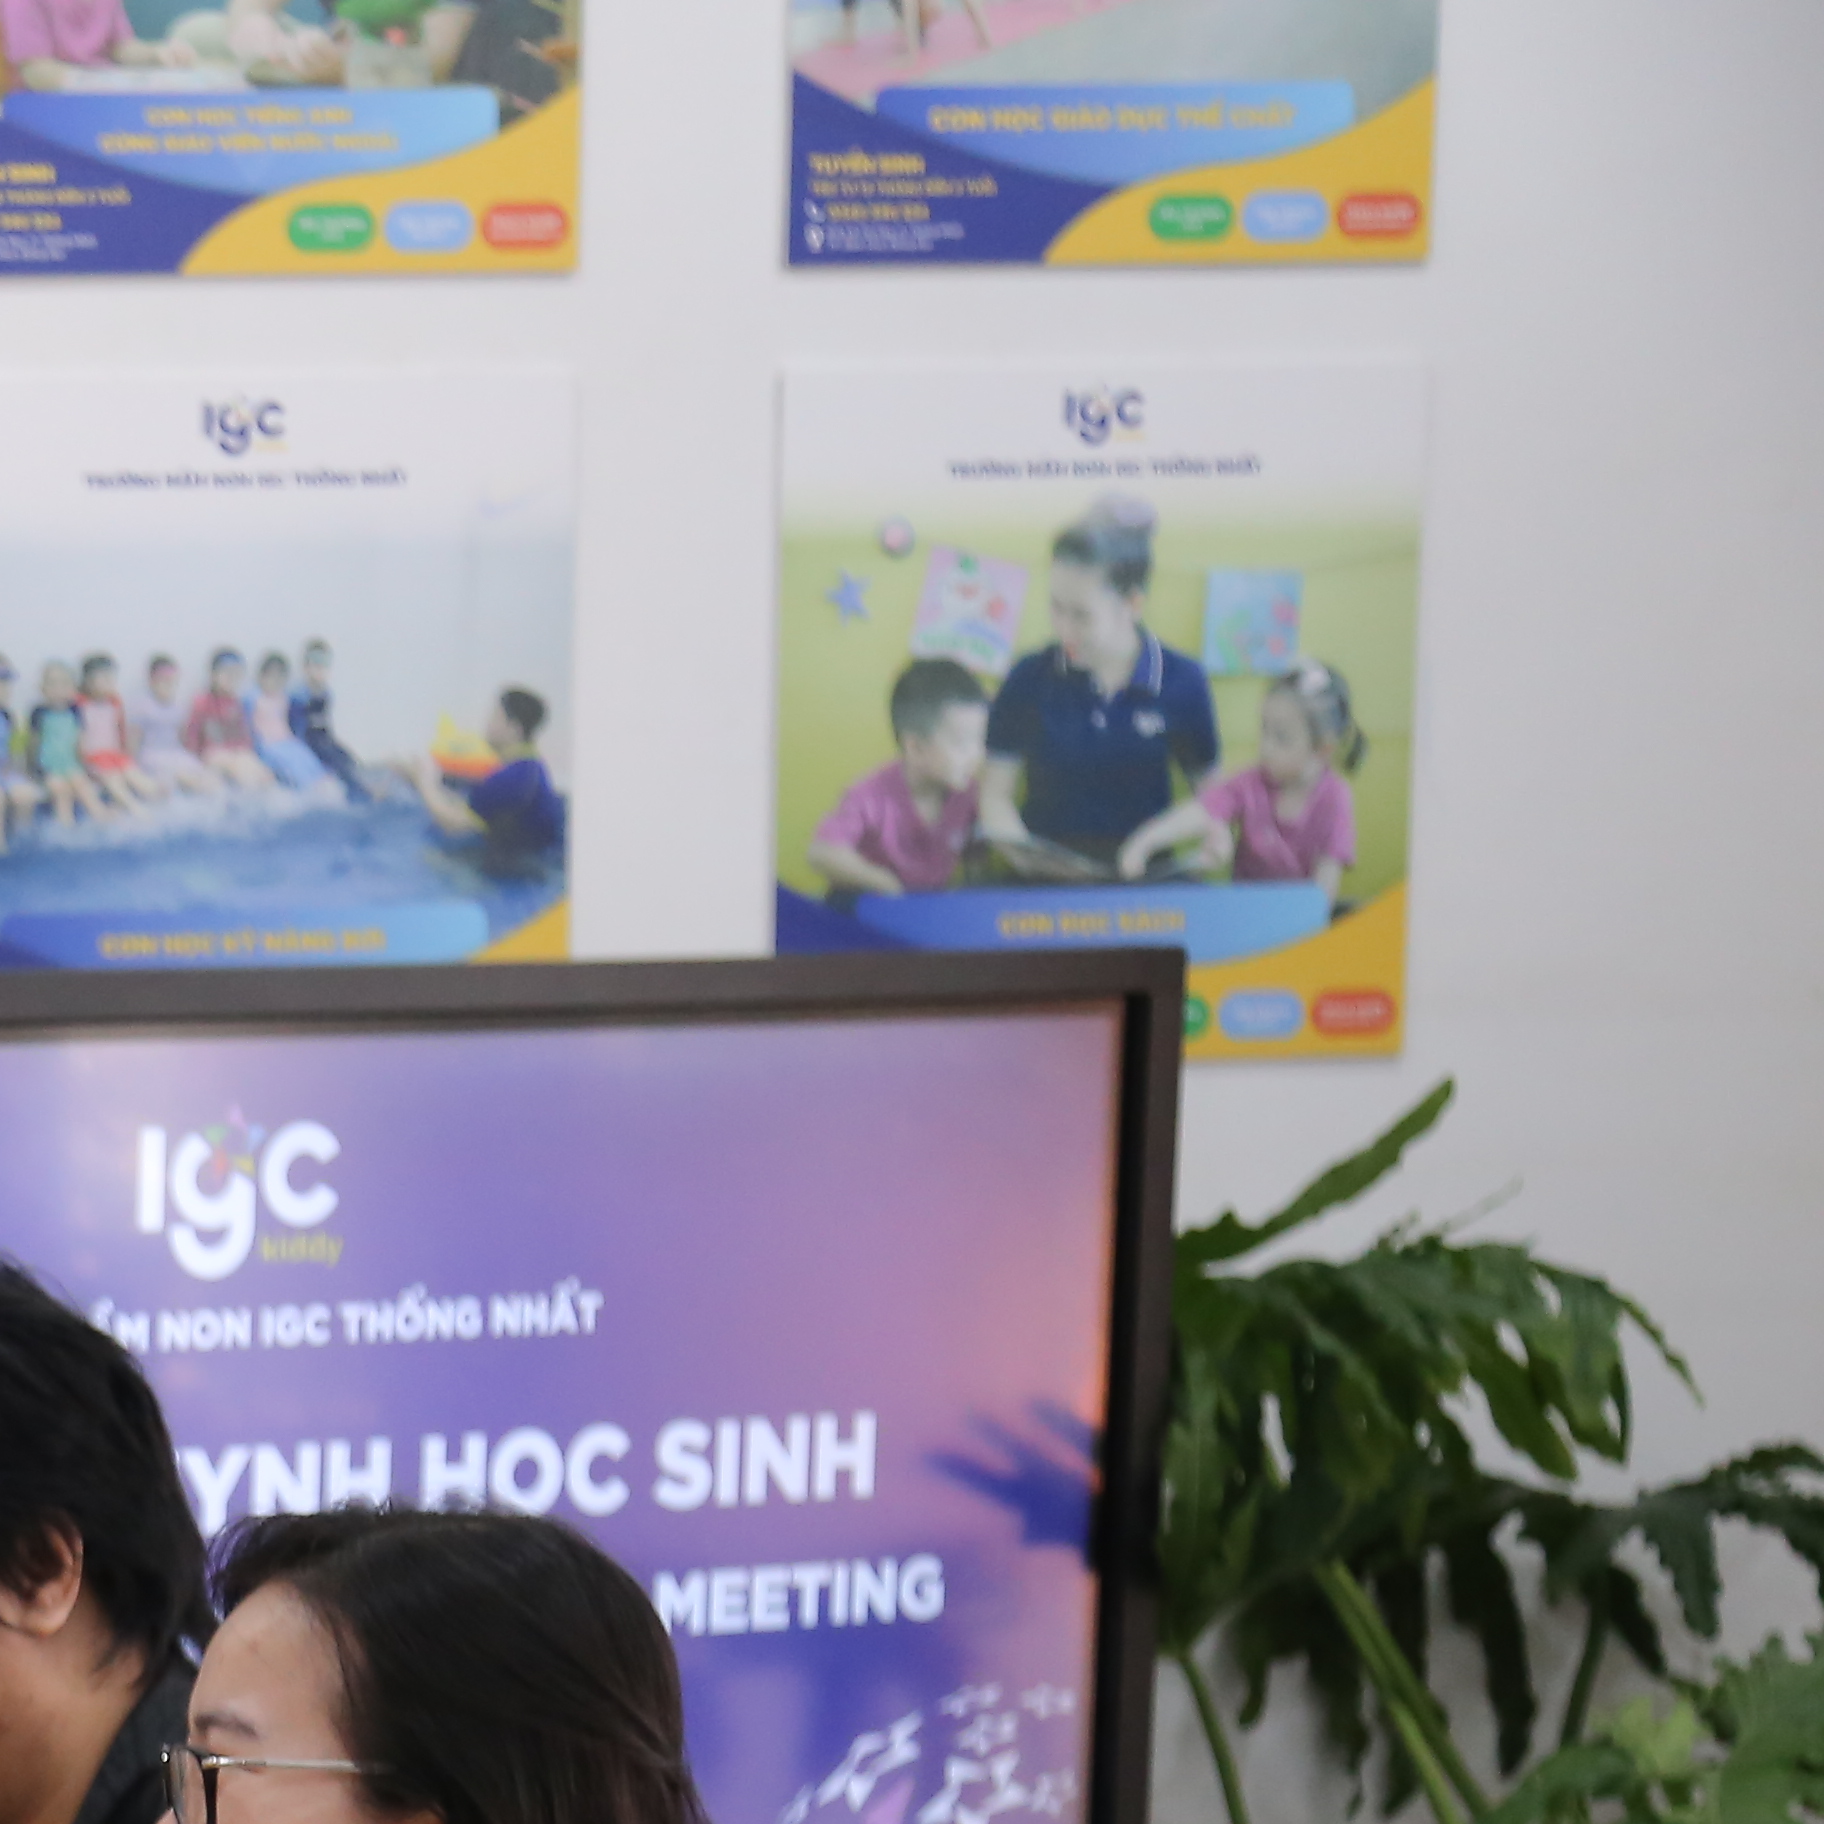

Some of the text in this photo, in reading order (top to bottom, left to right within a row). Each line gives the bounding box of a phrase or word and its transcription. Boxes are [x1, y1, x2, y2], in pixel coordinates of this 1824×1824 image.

[260, 1228, 345, 1268] kiddy
[156, 1306, 252, 1354] NON
[256, 1301, 333, 1350] IGC
[339, 1281, 485, 1345] THỐNG
[487, 1274, 607, 1338] NHẤT
[652, 1409, 879, 1512] SINH
[652, 1551, 947, 1640] MEETING
